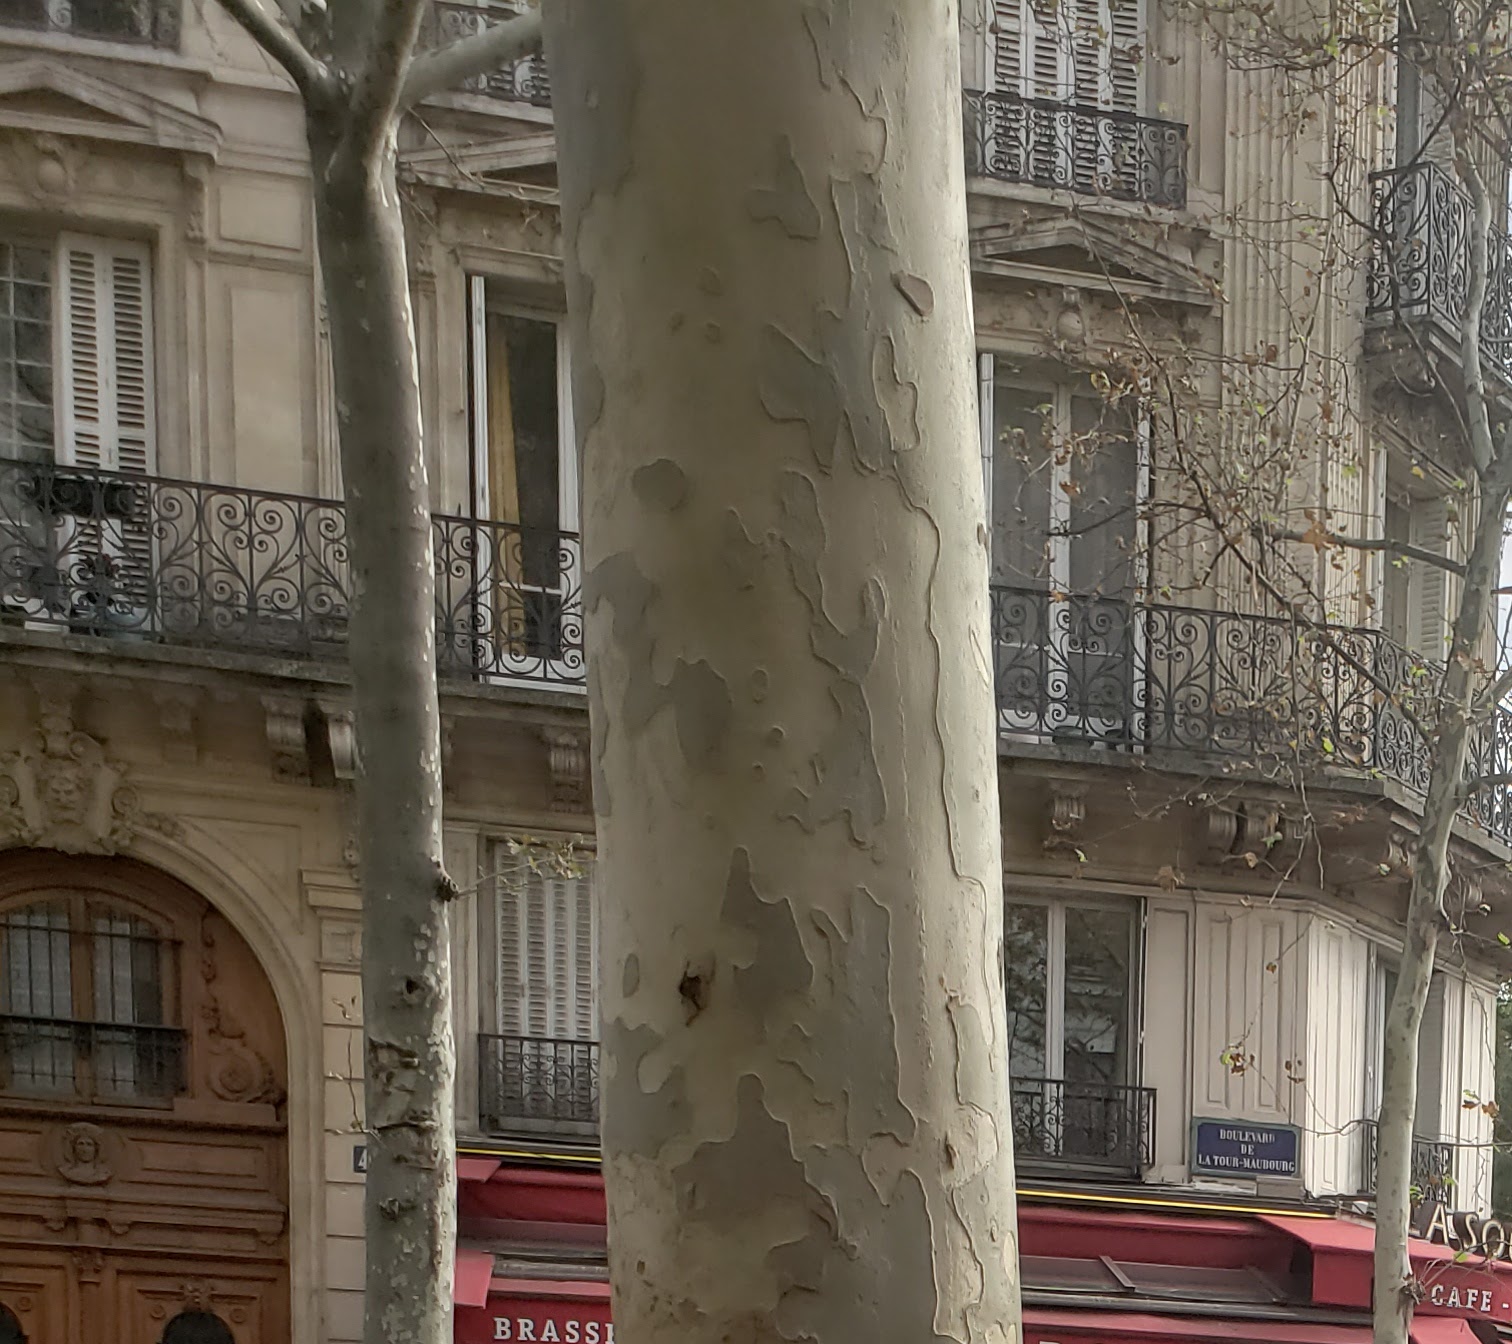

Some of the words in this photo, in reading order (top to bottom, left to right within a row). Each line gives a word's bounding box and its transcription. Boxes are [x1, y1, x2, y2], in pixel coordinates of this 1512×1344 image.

[1219, 1129, 1276, 1144] BOULEVARD
[1241, 1144, 1255, 1156] DE
[1198, 1154, 1212, 1166] LA
[1213, 1155, 1296, 1173] TOUR-MAUBOURG
[1430, 1284, 1493, 1312] CAFE
